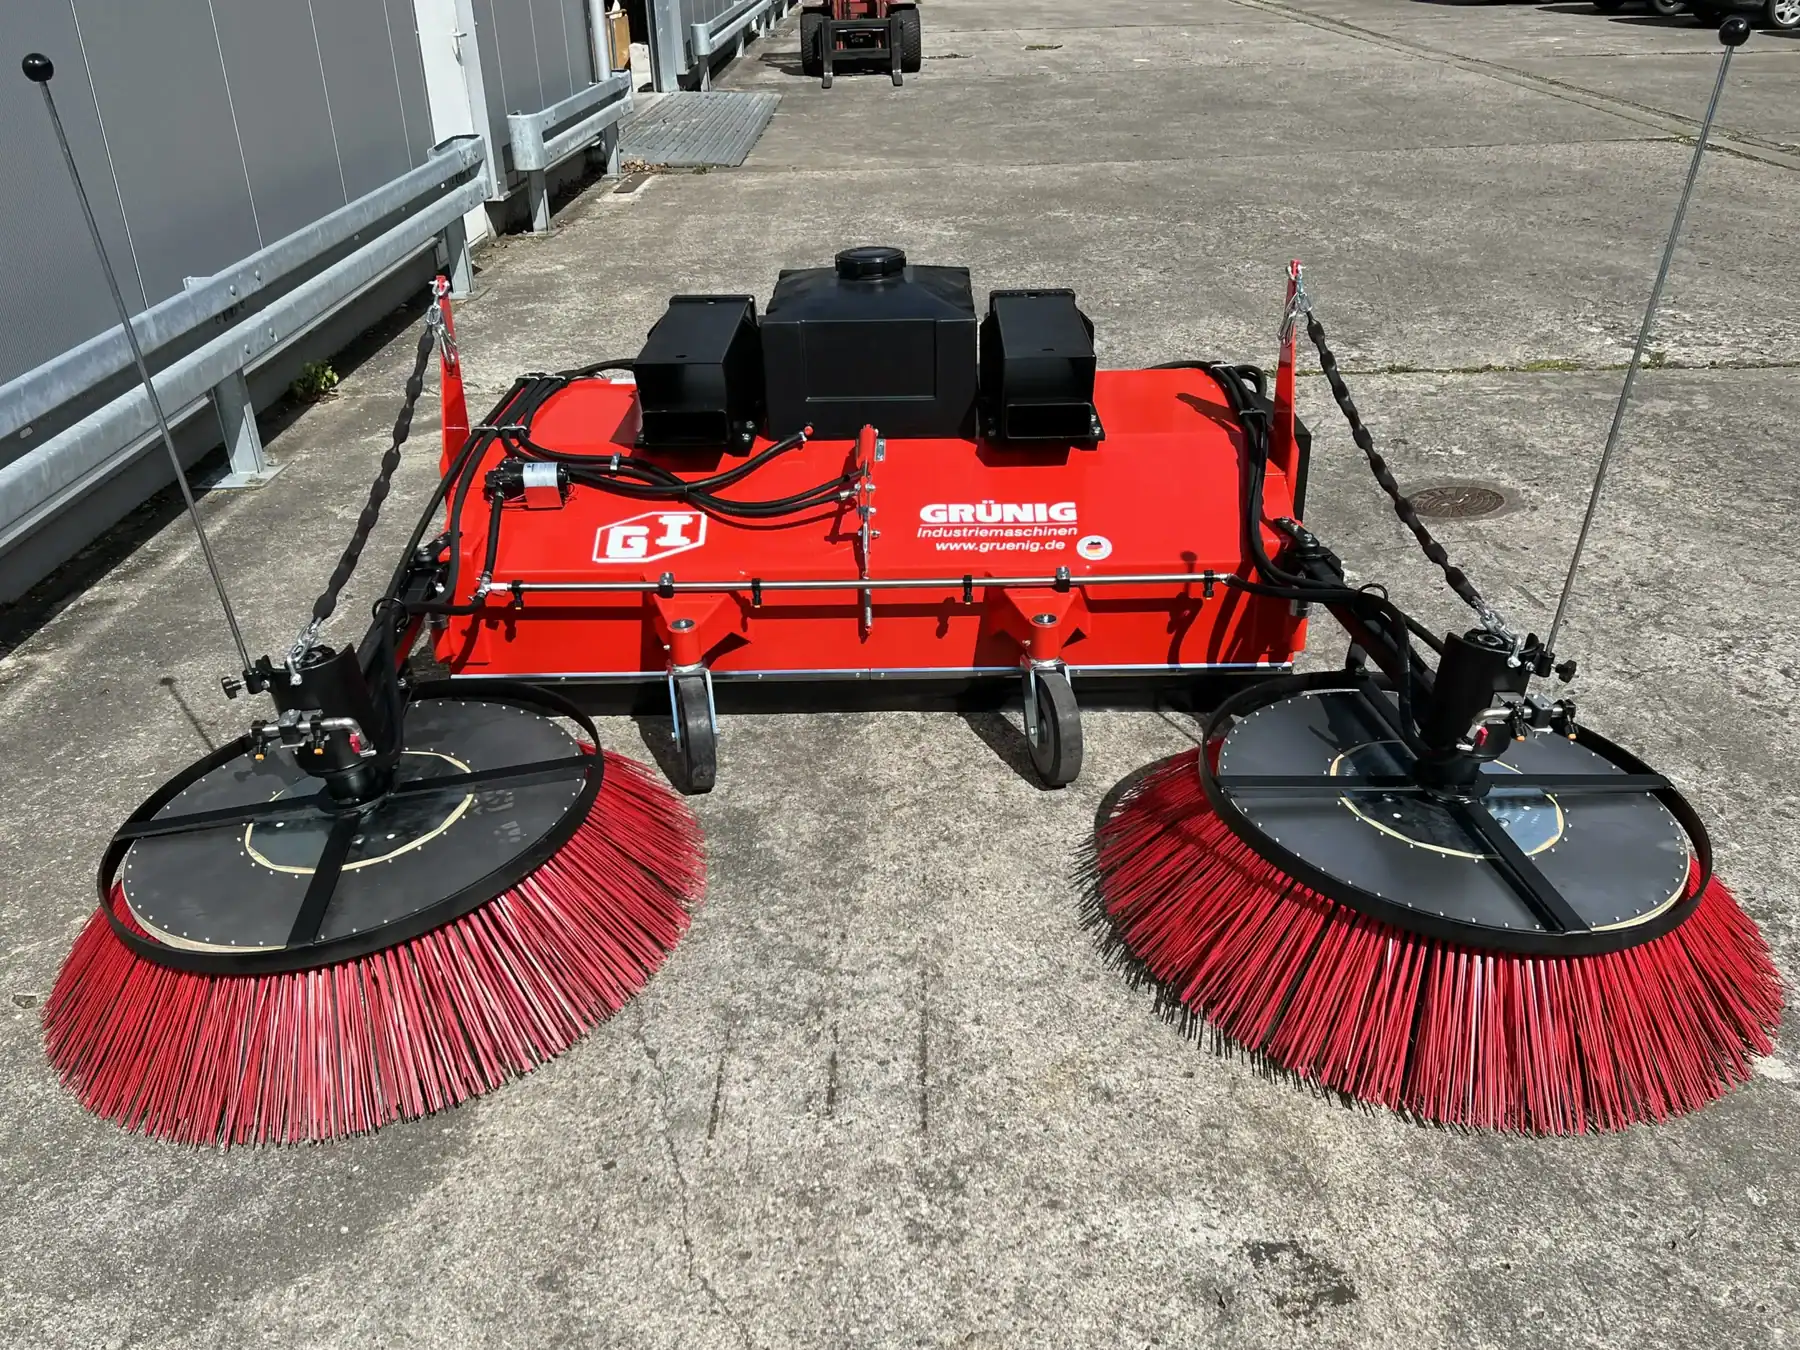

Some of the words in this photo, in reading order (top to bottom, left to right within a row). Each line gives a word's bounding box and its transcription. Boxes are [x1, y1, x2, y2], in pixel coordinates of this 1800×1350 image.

[920, 500, 1078, 523] GRÜNIG
[917, 526, 1078, 538] Industriemaschinen
[935, 540, 1066, 553] www.gruenig.de
